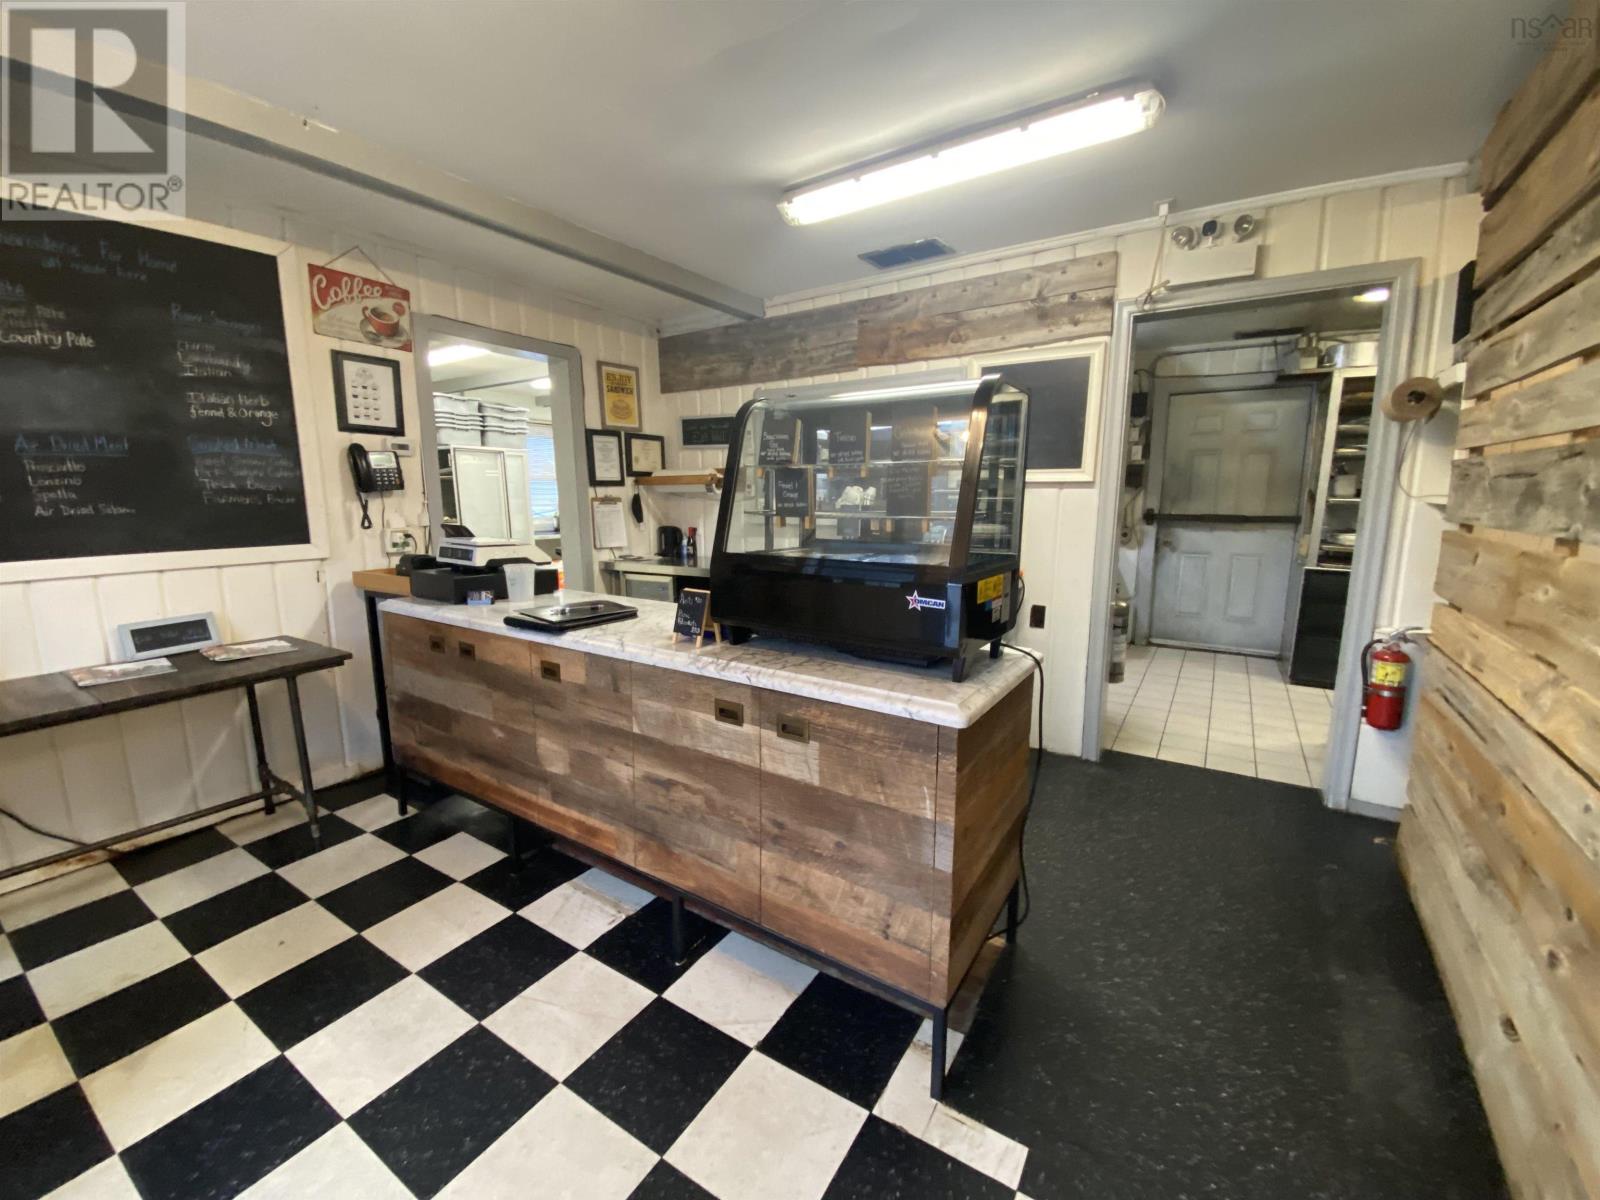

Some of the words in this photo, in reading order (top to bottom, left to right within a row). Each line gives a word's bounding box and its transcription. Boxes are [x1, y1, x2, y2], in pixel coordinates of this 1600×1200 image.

[312, 274, 382, 311] Coffee
[227, 407, 238, 418] &
[239, 408, 279, 427] Orange
[914, 597, 945, 608] OMCAN
